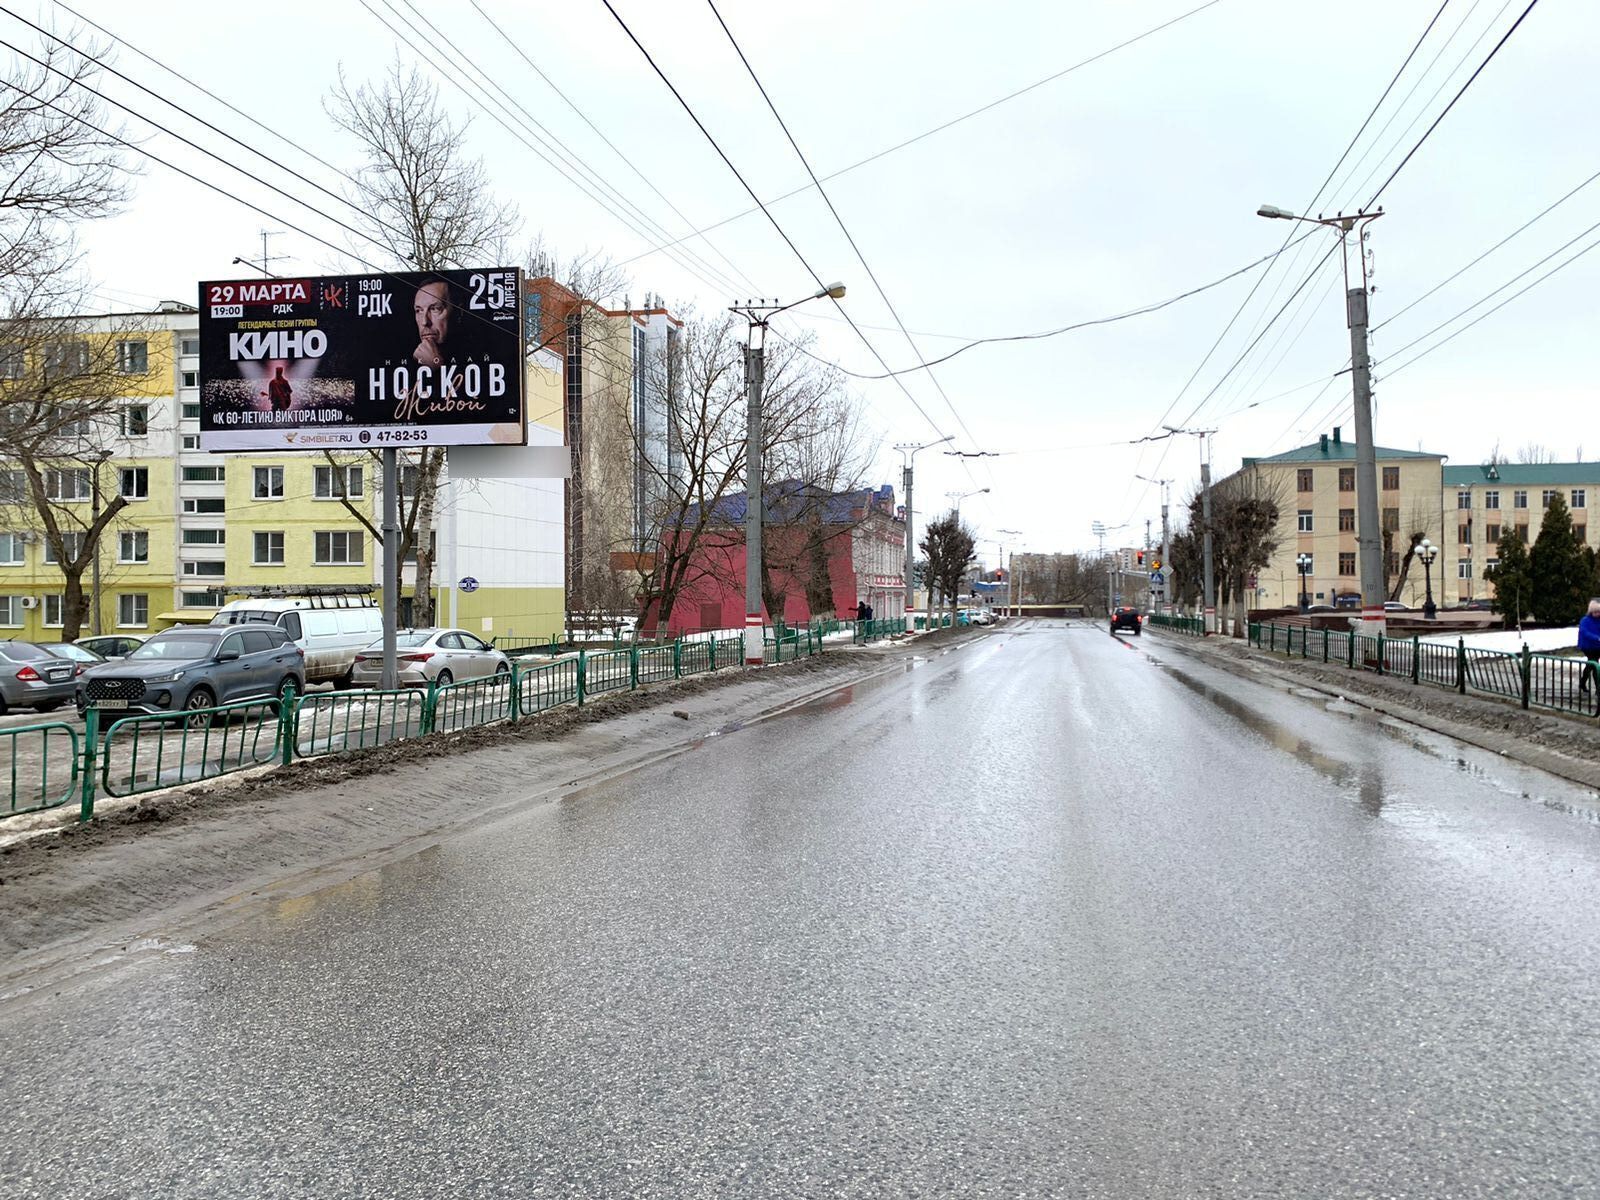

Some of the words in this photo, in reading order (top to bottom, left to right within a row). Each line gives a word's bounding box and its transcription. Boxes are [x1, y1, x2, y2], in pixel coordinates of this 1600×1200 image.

[211, 286, 234, 302] 29
[240, 283, 306, 301] МАРТА
[359, 279, 382, 291] 19:00
[469, 272, 504, 310] 25
[504, 272, 516, 309] АПРЕЛЯ
[214, 306, 241, 315] 19:00
[273, 303, 293, 314] РДК
[358, 293, 393, 317] РДК
[229, 329, 328, 361] КИНО
[369, 363, 506, 401] НОСКОВ
[213, 412, 224, 424] «К
[226, 410, 273, 424] 60-ЛЕТИЮ
[275, 409, 316, 423] ВИКТОРА
[318, 408, 343, 423] ЦОЯ»
[376, 430, 428, 442] 47-82-53
